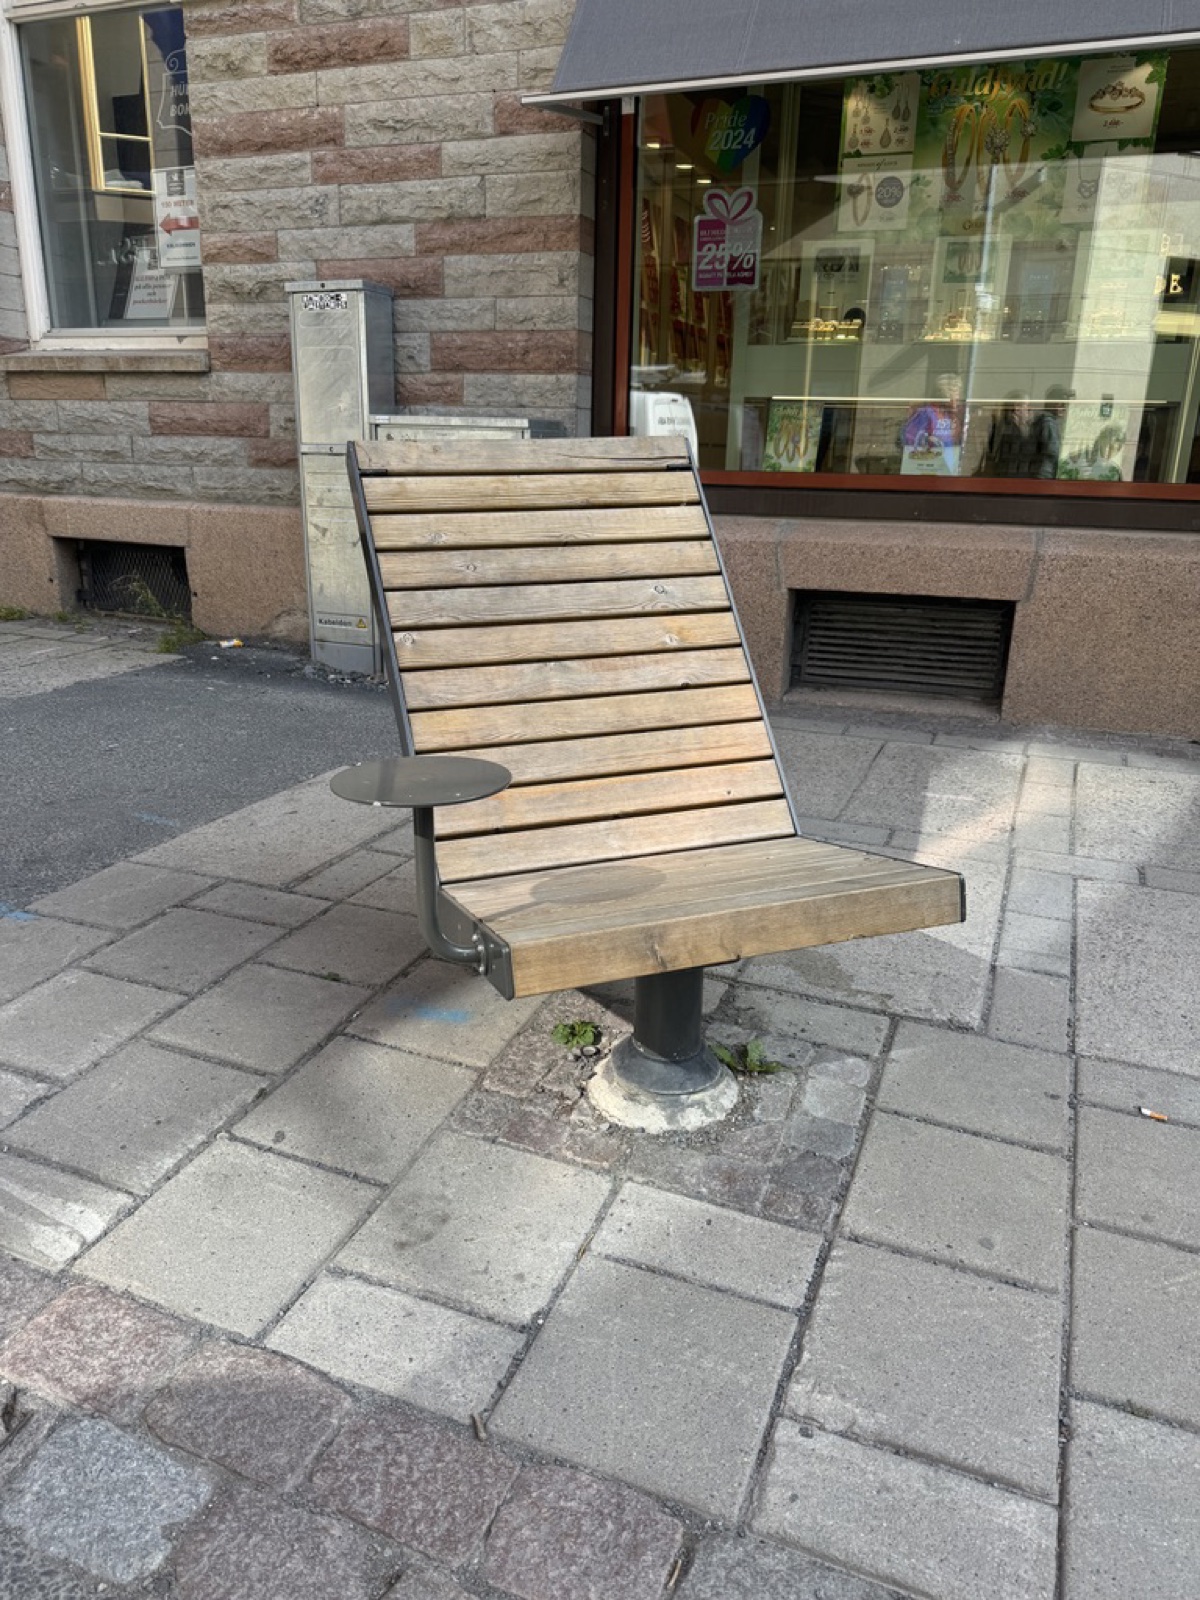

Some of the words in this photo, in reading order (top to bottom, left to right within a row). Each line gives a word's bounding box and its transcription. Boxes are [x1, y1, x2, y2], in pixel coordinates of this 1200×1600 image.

[929, 61, 1069, 102] Guldfynd!
[705, 111, 747, 129] Pride
[708, 127, 756, 150] 2024
[698, 242, 754, 270] 25%
